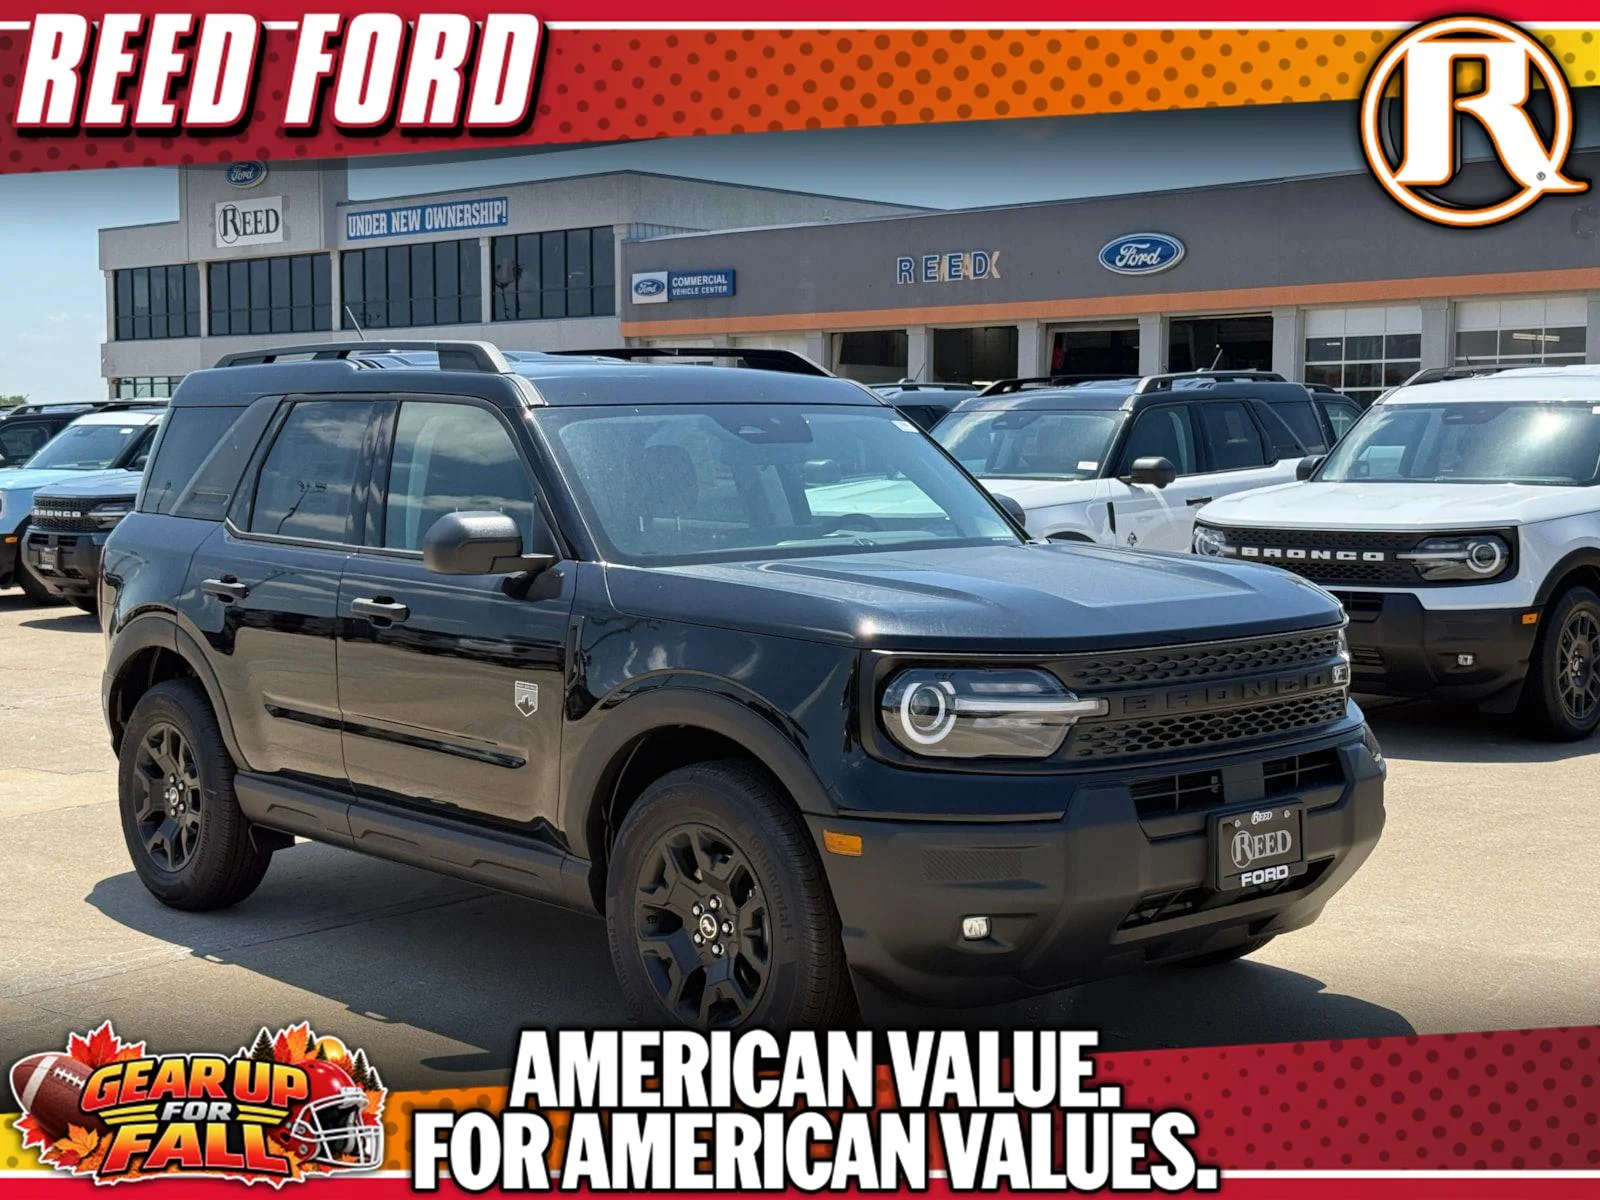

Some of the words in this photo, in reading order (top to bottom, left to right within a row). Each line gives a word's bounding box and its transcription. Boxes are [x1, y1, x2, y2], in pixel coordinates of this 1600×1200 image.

[230, 164, 254, 181] Ford
[221, 206, 280, 238] REED
[348, 213, 387, 237] UNDER
[391, 209, 421, 233] NEW
[425, 200, 507, 230] OWNERSHIP!
[1115, 243, 1162, 267] Ford
[638, 281, 658, 294] Ford
[672, 274, 728, 287] COMMERCIAL
[672, 287, 699, 296] VEHICLE
[701, 285, 728, 294] CENTER
[1241, 547, 1384, 561] BRONCO
[1122, 671, 1327, 714] BRONCO
[1232, 829, 1292, 864] REED
[1241, 864, 1289, 887] FORD
